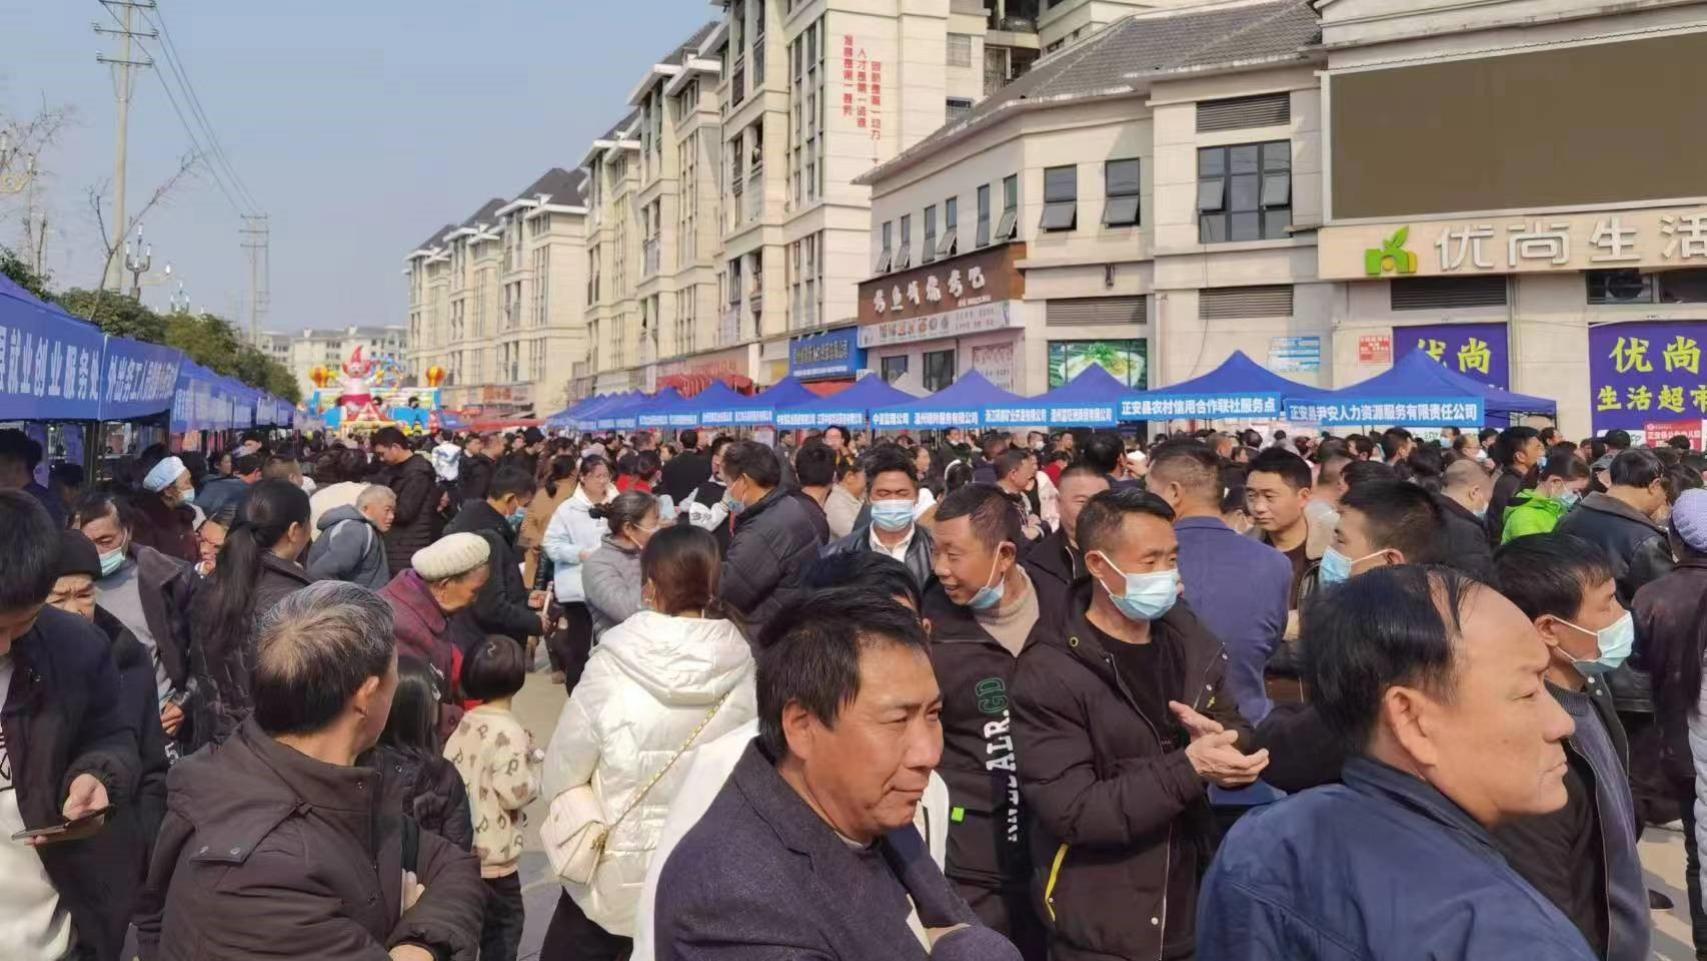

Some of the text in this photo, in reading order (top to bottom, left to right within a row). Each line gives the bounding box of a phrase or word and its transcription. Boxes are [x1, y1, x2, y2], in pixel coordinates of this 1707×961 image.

[1435, 214, 1707, 271] 优尚生活
[1609, 335, 1702, 375] 优尚
[1121, 397, 1276, 416] 正安县农村信用合作联社服务点
[1289, 403, 1477, 421] 正安县尹安人力资源服务有限责任公司
[1597, 384, 1707, 413] 生活超市
